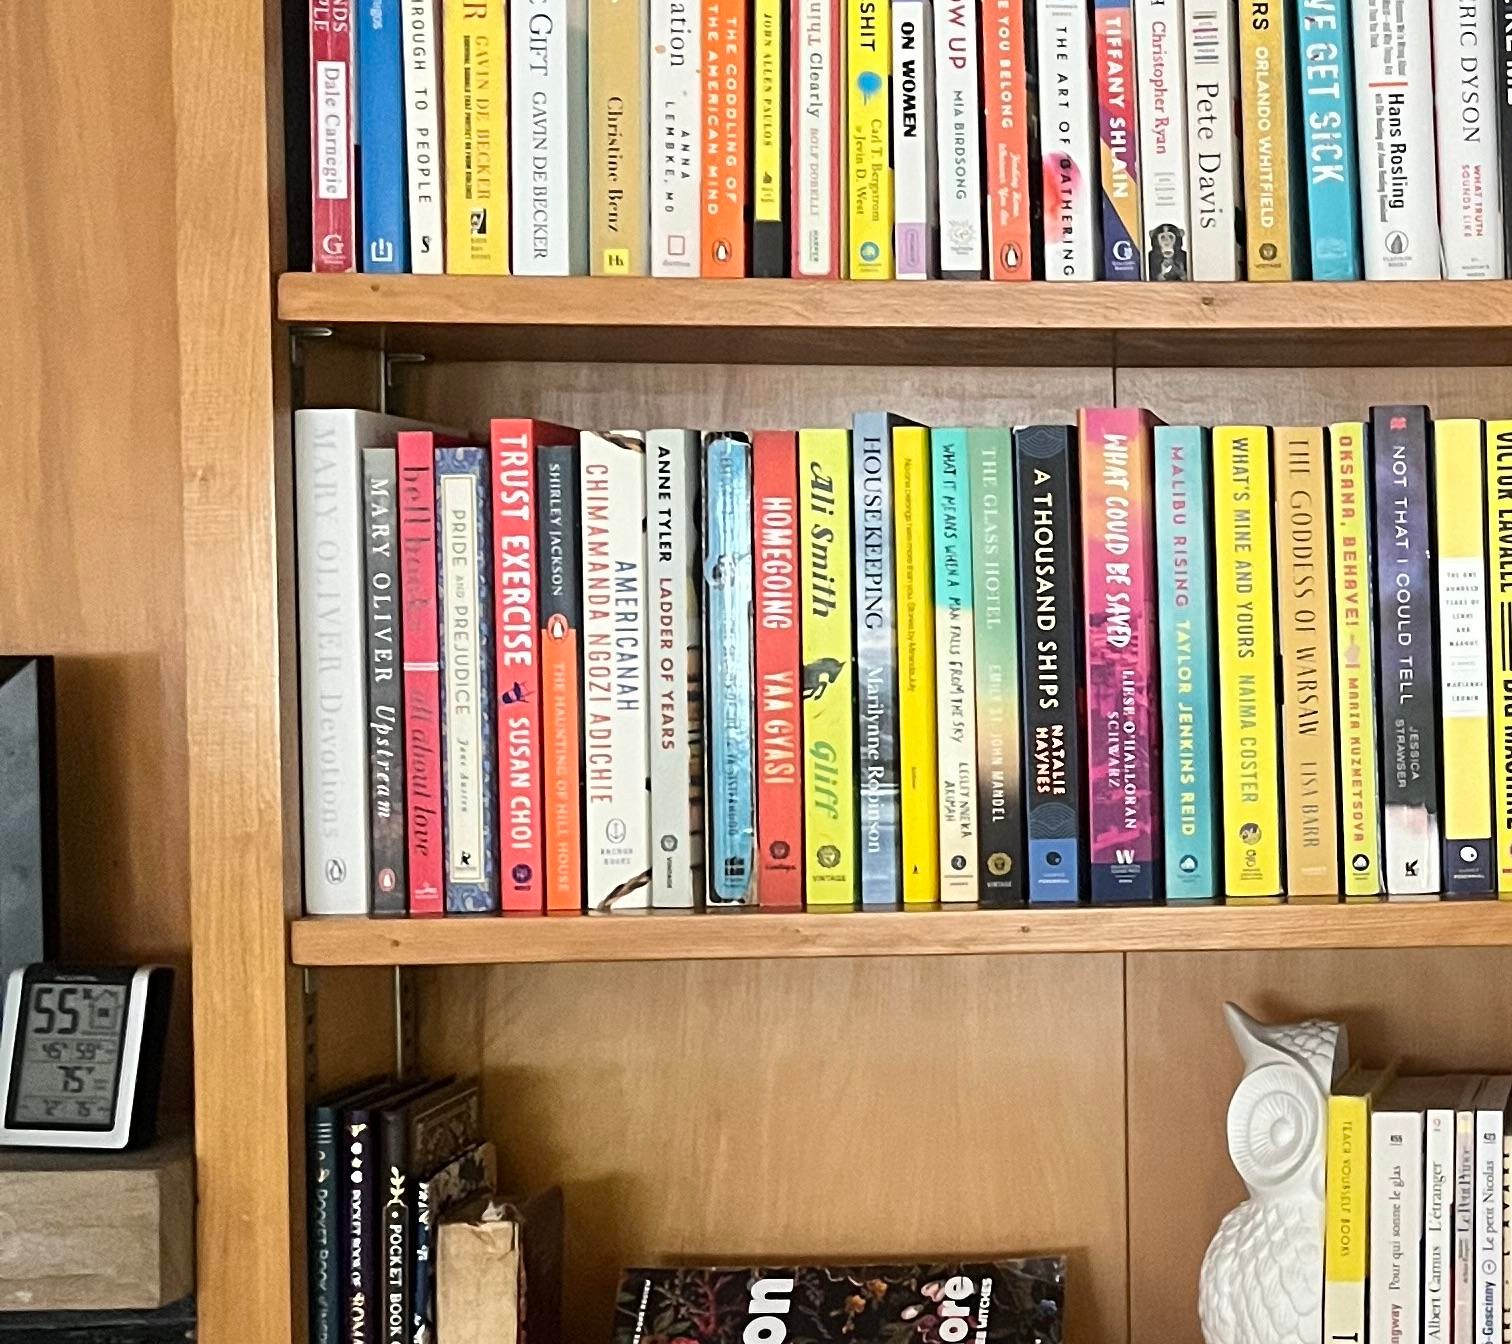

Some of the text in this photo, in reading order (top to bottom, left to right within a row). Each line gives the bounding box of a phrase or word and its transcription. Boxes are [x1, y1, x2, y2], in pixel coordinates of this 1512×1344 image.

[529, 14, 552, 76] GIFT
[900, 21, 917, 137] ON WOMEN
[1307, 43, 1338, 103] GET
[607, 97, 624, 233] Christine Benz
[1105, 17, 1129, 198] TIFFANY SHLAIN
[1196, 82, 1222, 229] Pete Davis
[1311, 112, 1345, 184] SICK
[1387, 93, 1405, 137] Hans
[1388, 144, 1408, 209] Rosling
[371, 478, 392, 683] MARY OLIVER
[500, 434, 532, 666] TRUST EXERCISE
[762, 497, 794, 629] HOMEGOING
[1034, 469, 1058, 709] A THOUSAND SHIPS
[371, 705, 395, 819] Upstream
[510, 717, 532, 849] SUSAN CHOI
[766, 671, 795, 784] YAA GYASI
